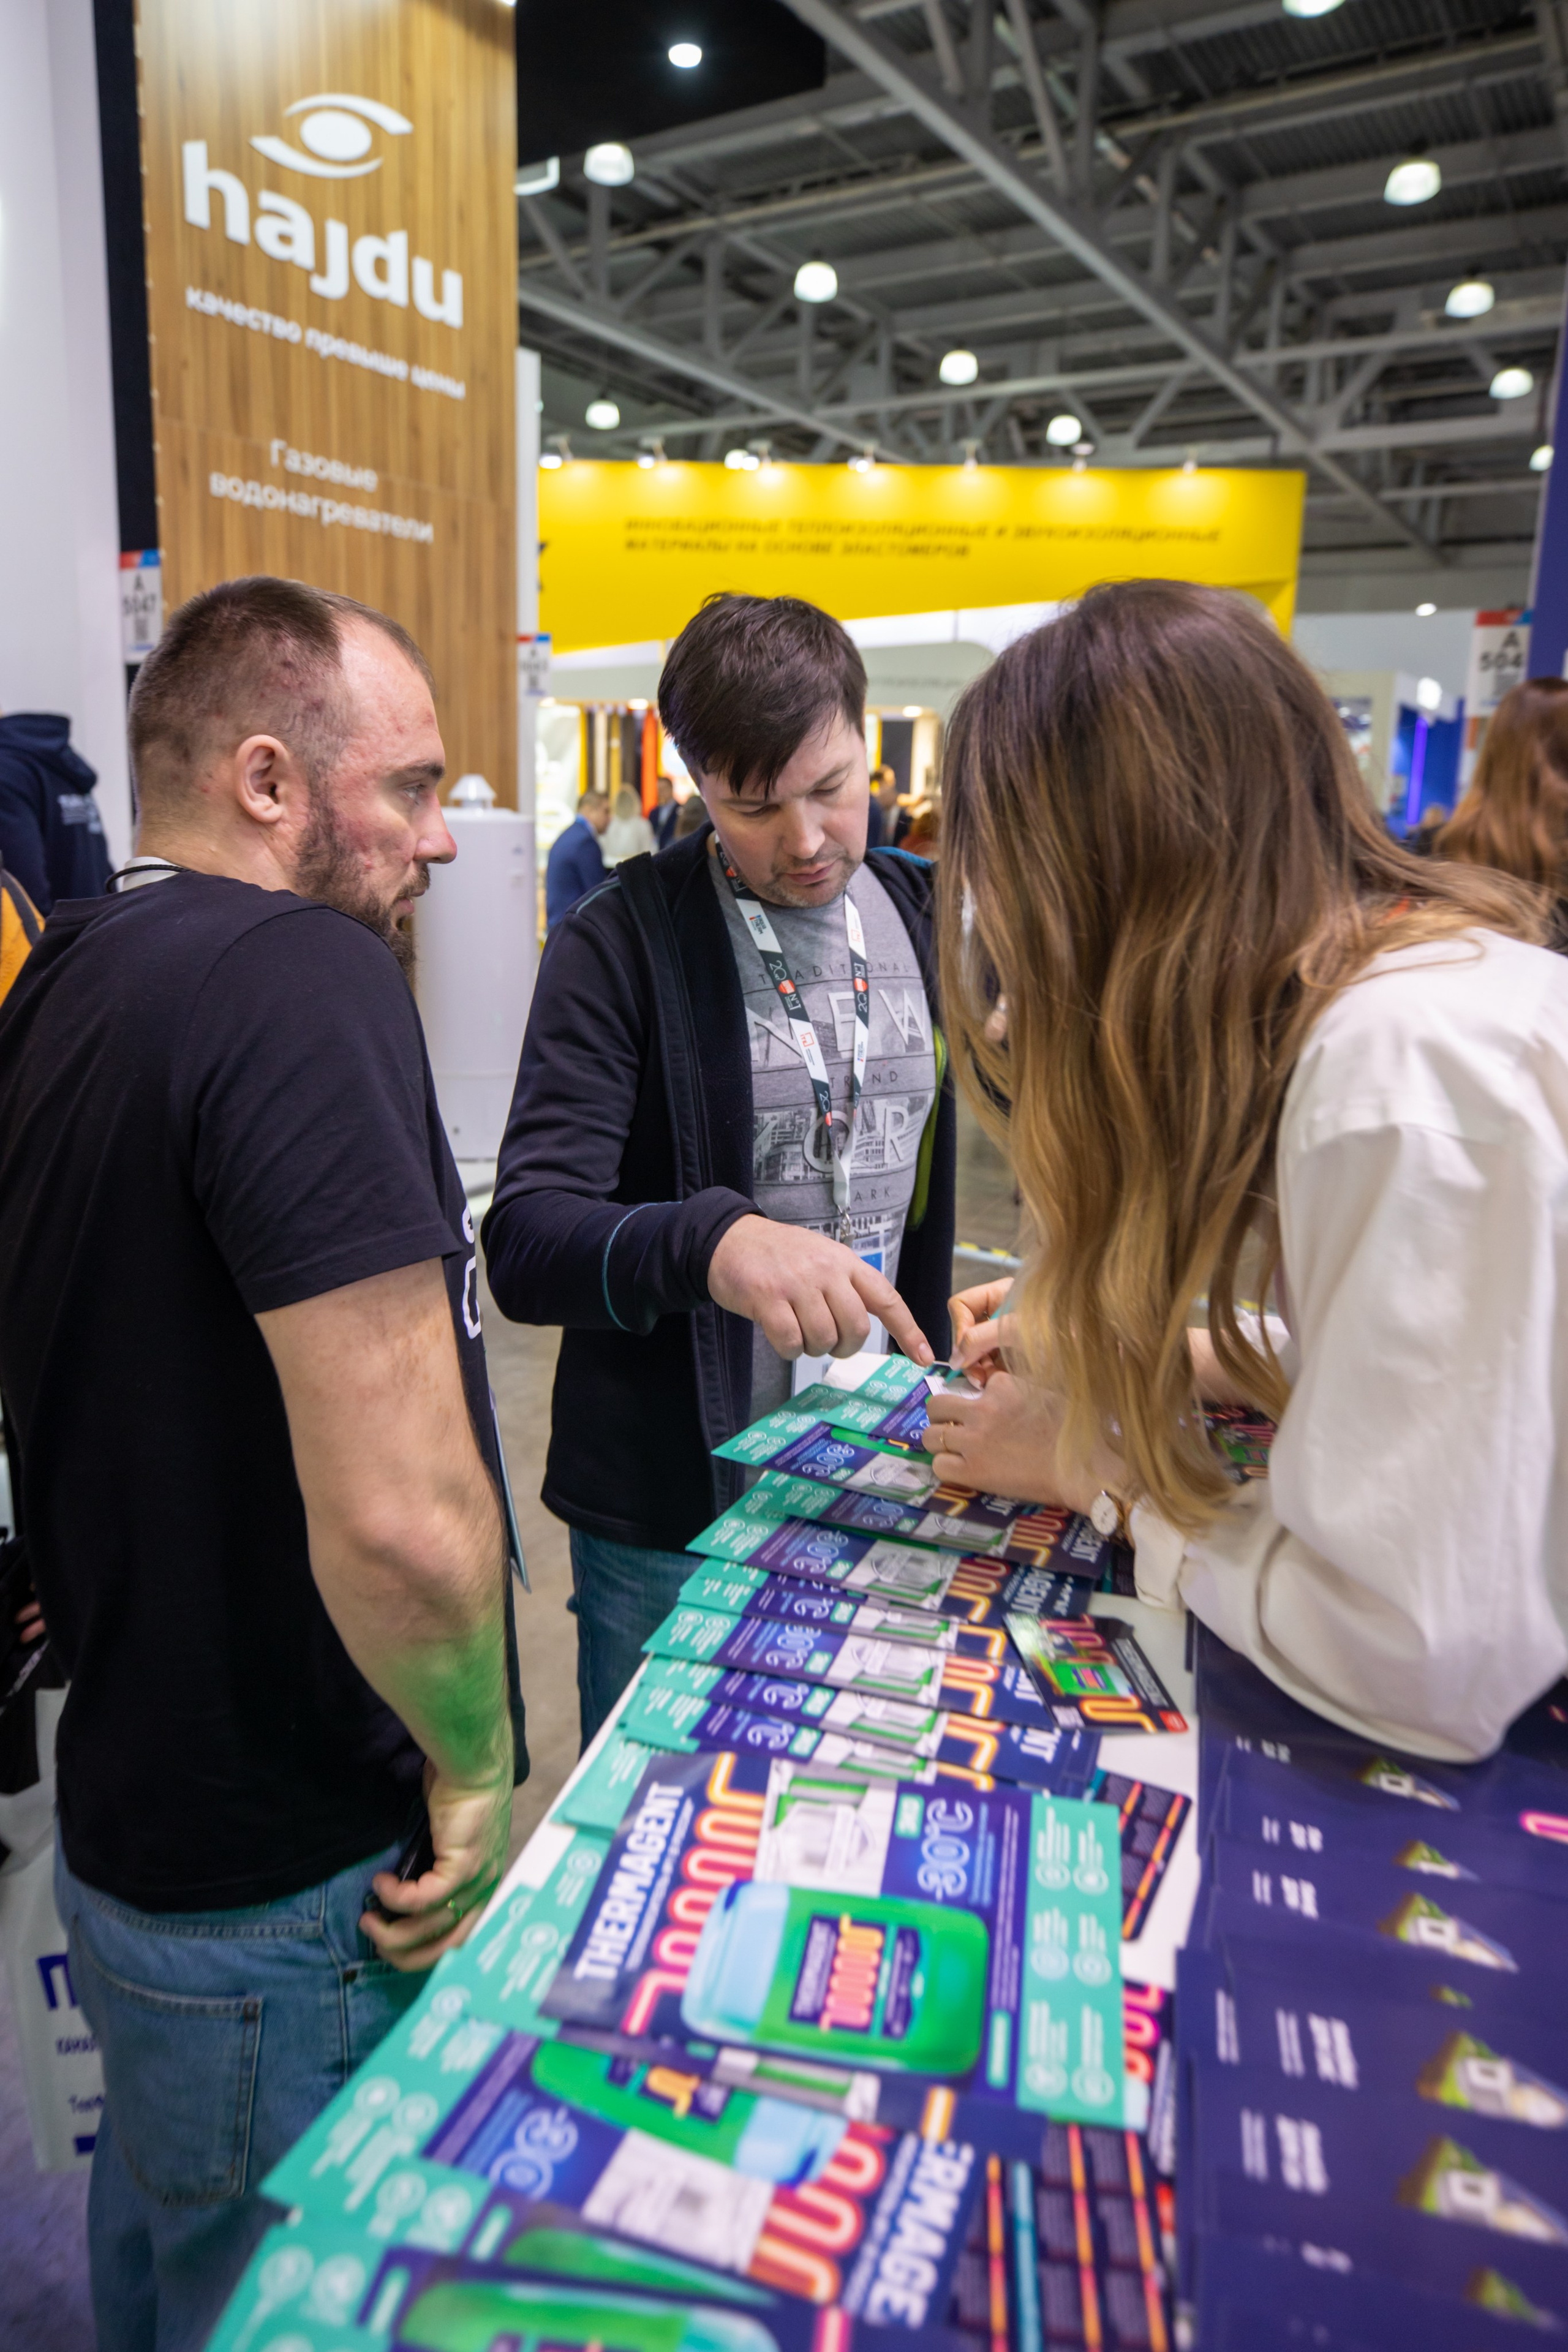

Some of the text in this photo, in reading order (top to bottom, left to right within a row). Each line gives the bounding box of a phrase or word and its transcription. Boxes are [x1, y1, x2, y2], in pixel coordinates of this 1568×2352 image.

[182, 140, 464, 329] hajdu
[305, 327, 409, 382] превыше
[411, 364, 466, 401] цены
[270, 438, 378, 492] Газовые
[209, 472, 434, 544] водонагреватели
[758, 961, 910, 984] TADITONAL
[829, 1071, 899, 1088] TRND
[854, 1187, 892, 1203] ARK
[573, 1782, 685, 1981] THERMAGENT
